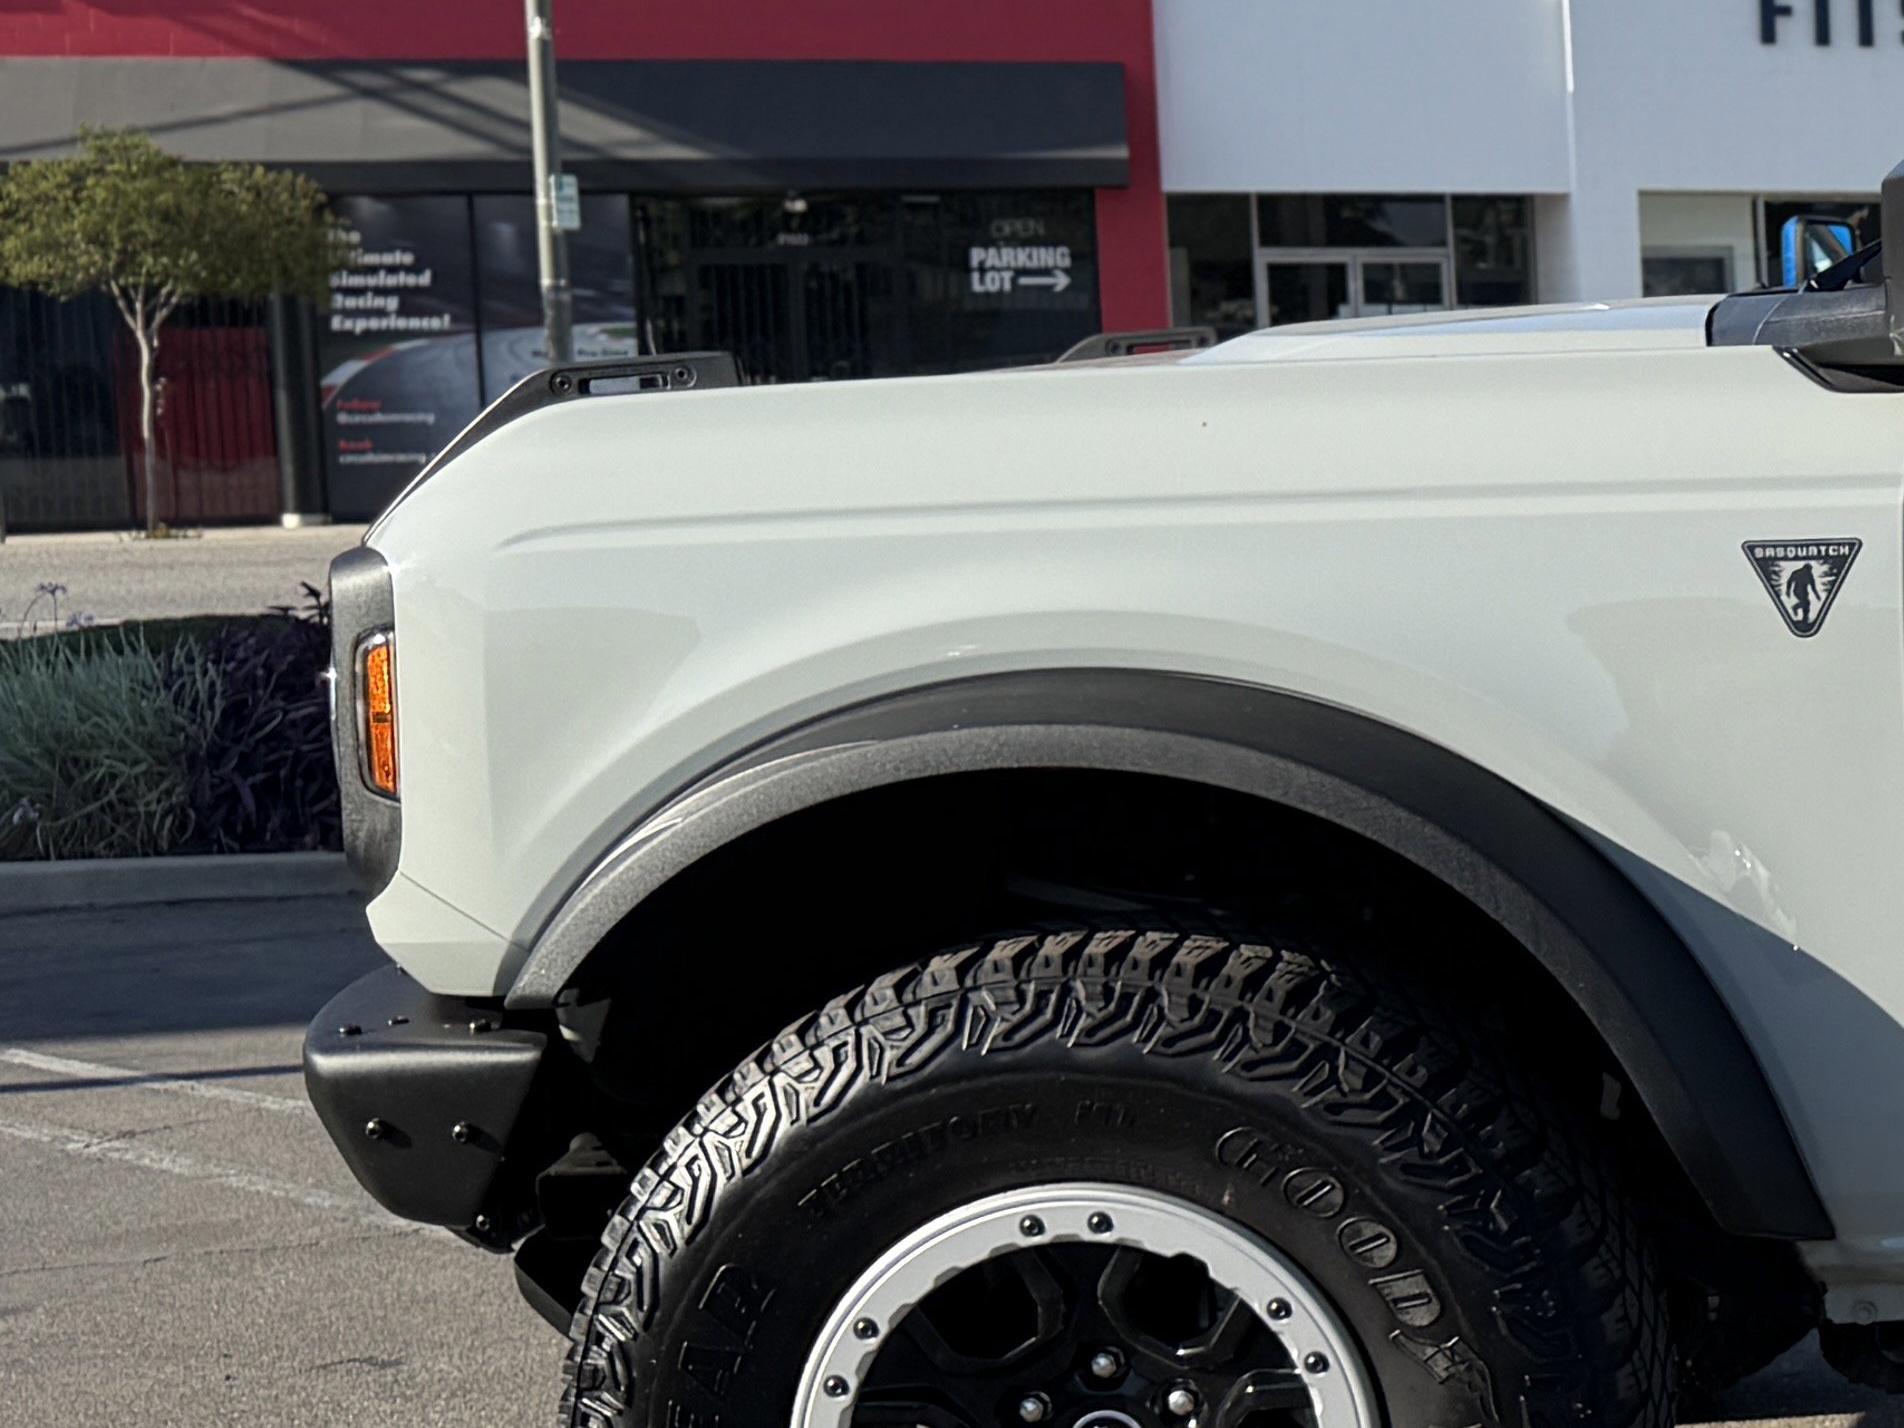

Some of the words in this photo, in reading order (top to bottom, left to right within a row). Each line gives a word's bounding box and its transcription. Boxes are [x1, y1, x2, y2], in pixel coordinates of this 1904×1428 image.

[969, 246, 1071, 269] PARKING
[971, 271, 1014, 293] LOT
[331, 313, 451, 335] Experience!
[1753, 545, 1850, 559] SASQUATCH
